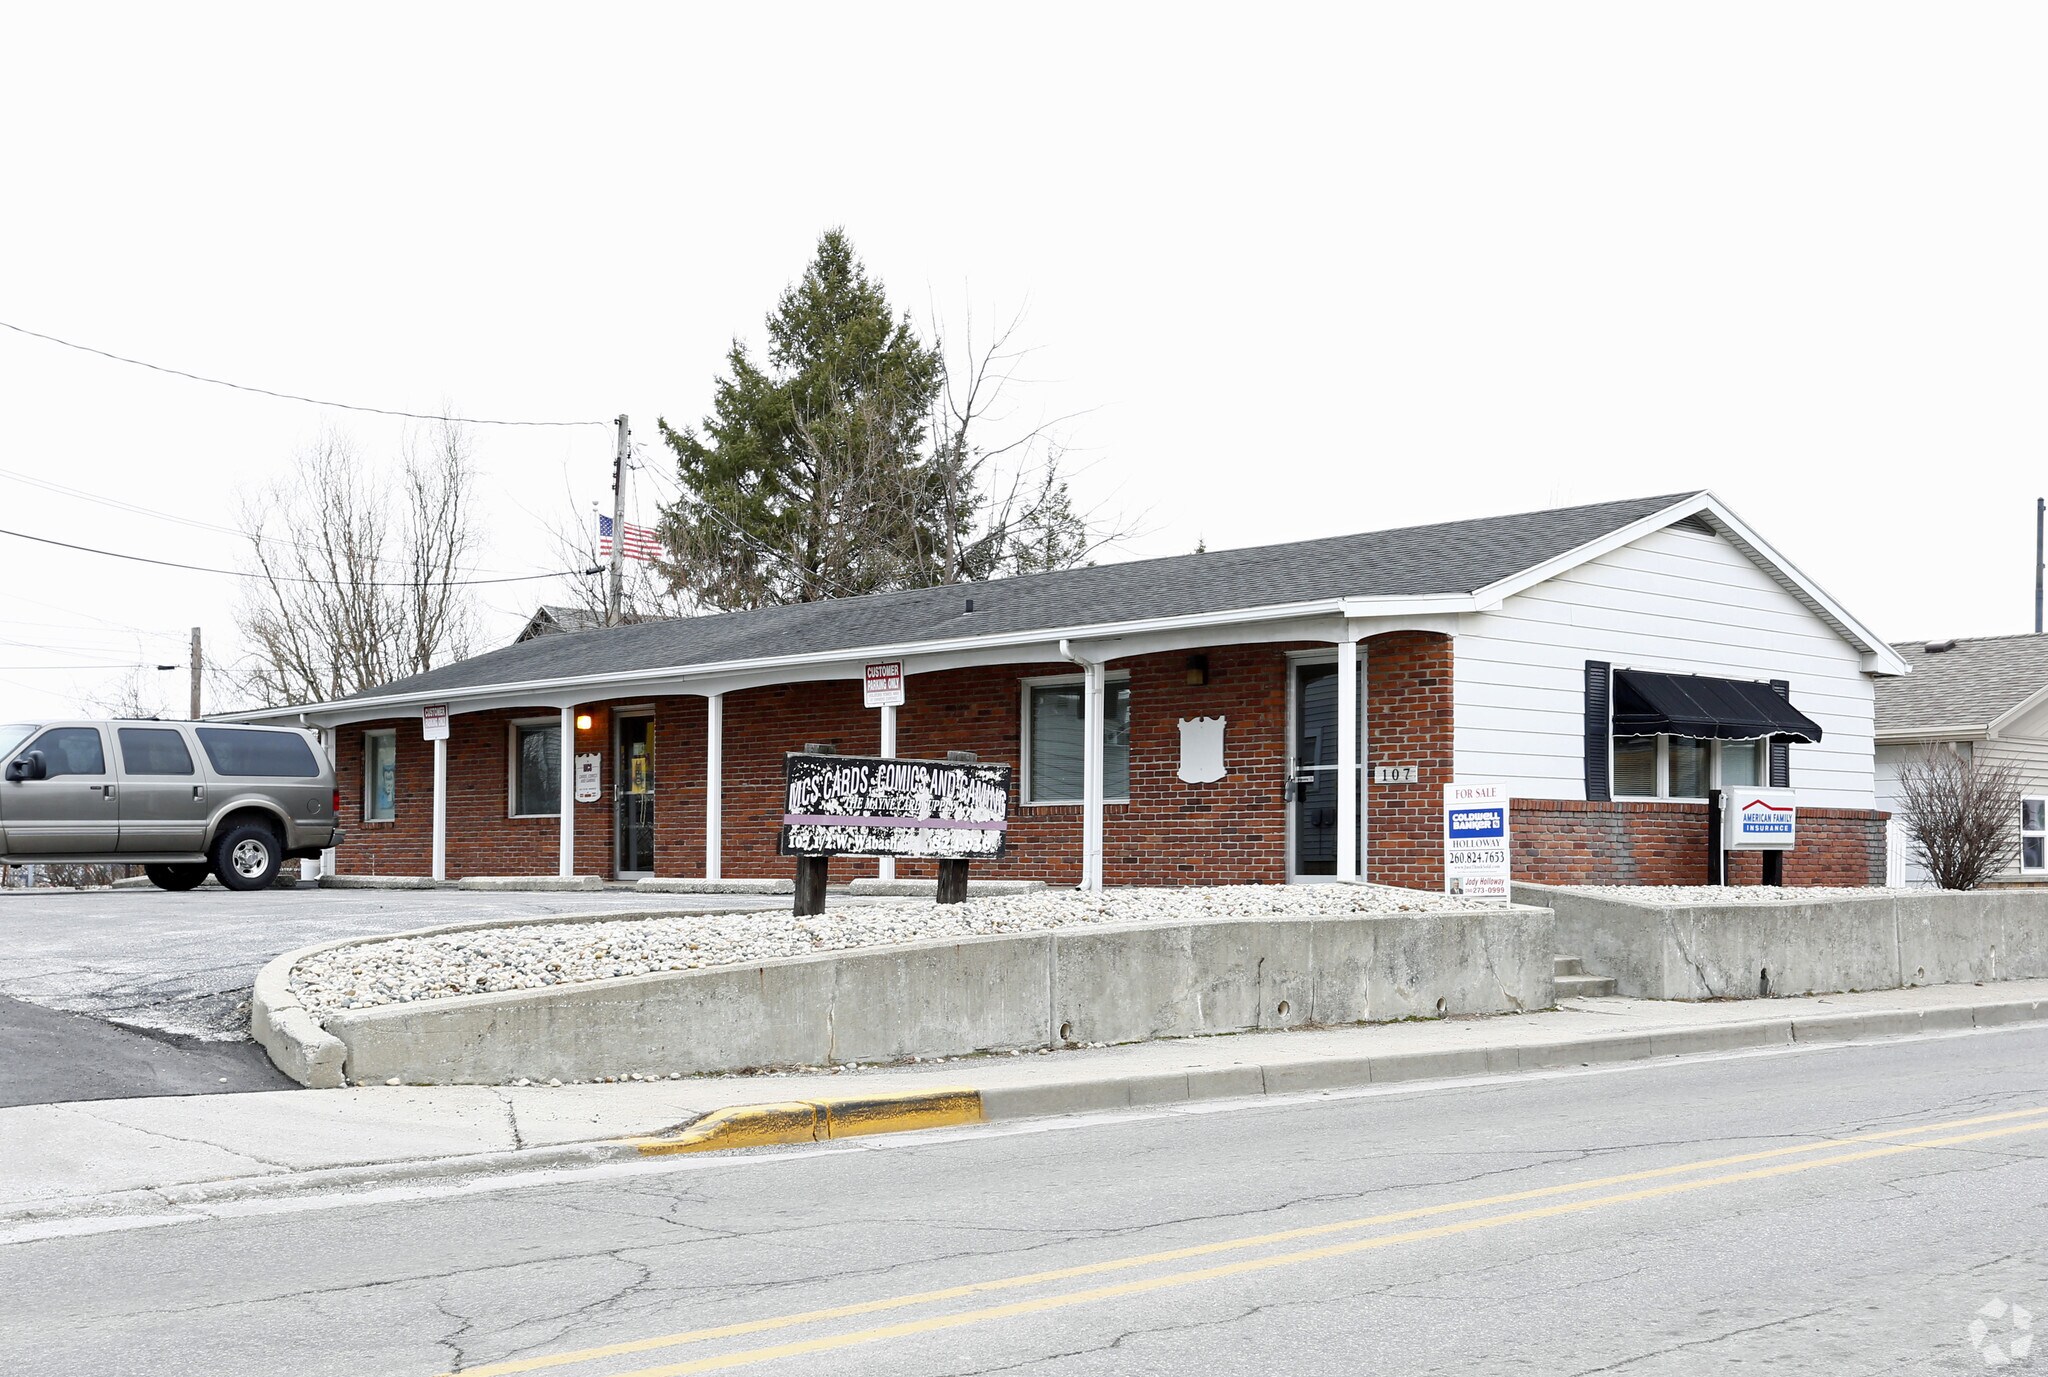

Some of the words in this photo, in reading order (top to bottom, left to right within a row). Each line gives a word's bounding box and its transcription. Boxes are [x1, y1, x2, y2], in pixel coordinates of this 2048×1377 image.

[867, 665, 899, 678] CUSTOMER
[867, 678, 887, 691] PARKING
[887, 677, 900, 689] ONLY
[1382, 768, 1410, 781] 107
[788, 775, 819, 810] MCS
[877, 764, 927, 794] COMICS
[930, 769, 956, 798] AND
[959, 775, 1007, 817] GAMING
[1455, 789, 1473, 799] FOR
[1475, 787, 1497, 798] SALE
[844, 797, 864, 810] THE
[1743, 813, 1772, 822] AMERICAN
[1773, 814, 1793, 822] FAMILY
[1452, 839, 1501, 848] HOLLOWAY
[1449, 851, 1505, 864] 260.824.7653
[1465, 878, 1478, 887] Jody
[1479, 877, 1505, 886] Holloway
